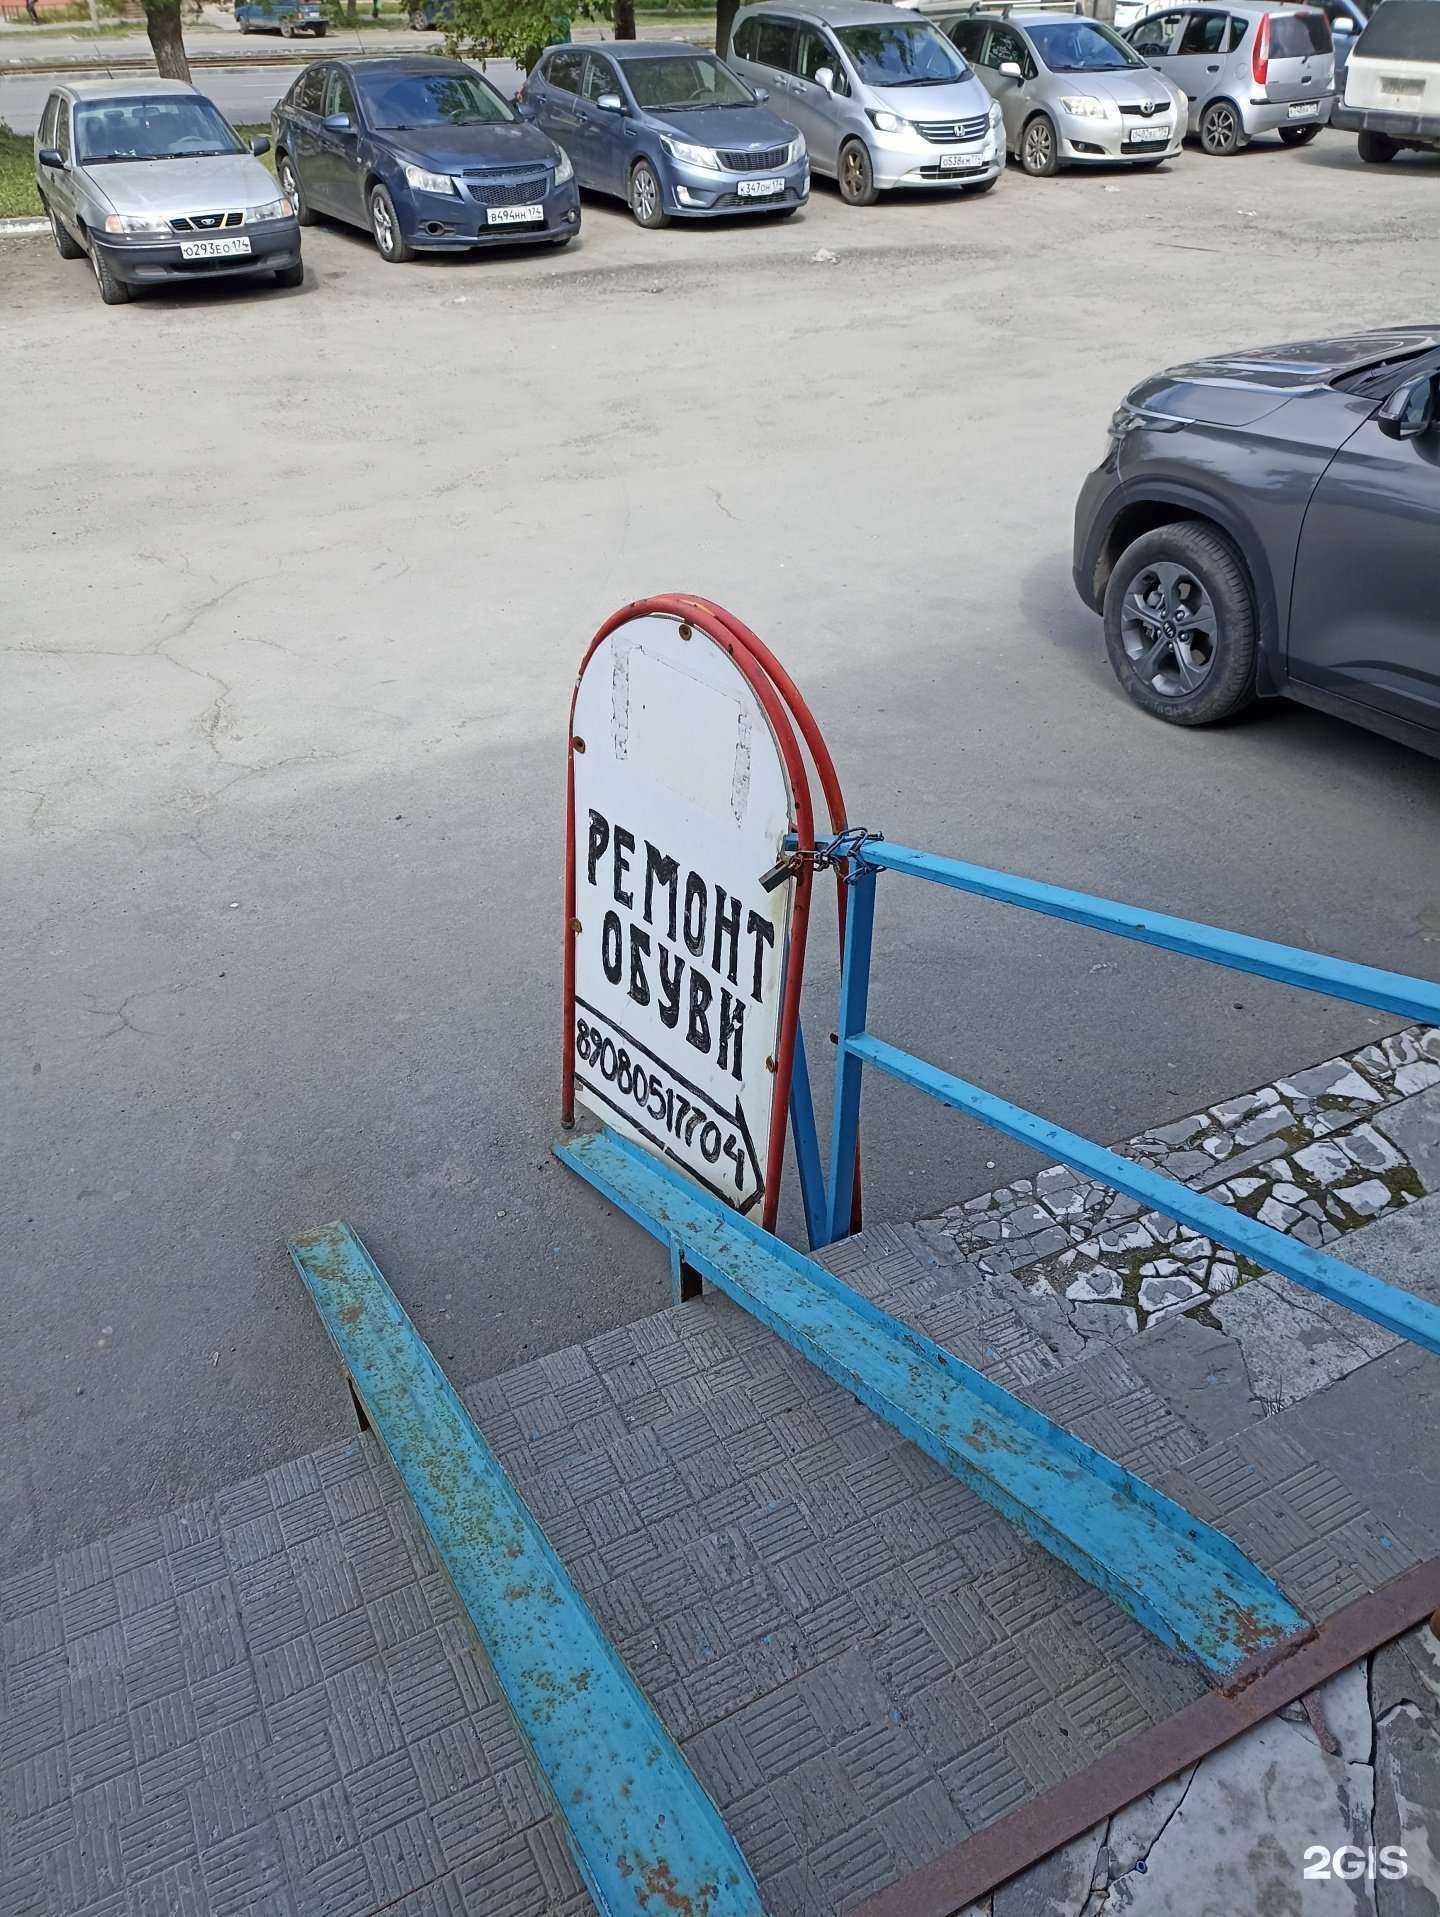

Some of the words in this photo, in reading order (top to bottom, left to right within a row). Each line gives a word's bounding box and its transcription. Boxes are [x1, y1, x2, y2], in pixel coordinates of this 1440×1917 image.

[588, 808, 774, 1003] РЕМОНТ
[602, 910, 745, 1081] ОБУВИ
[576, 1018, 745, 1191] 89080517704
